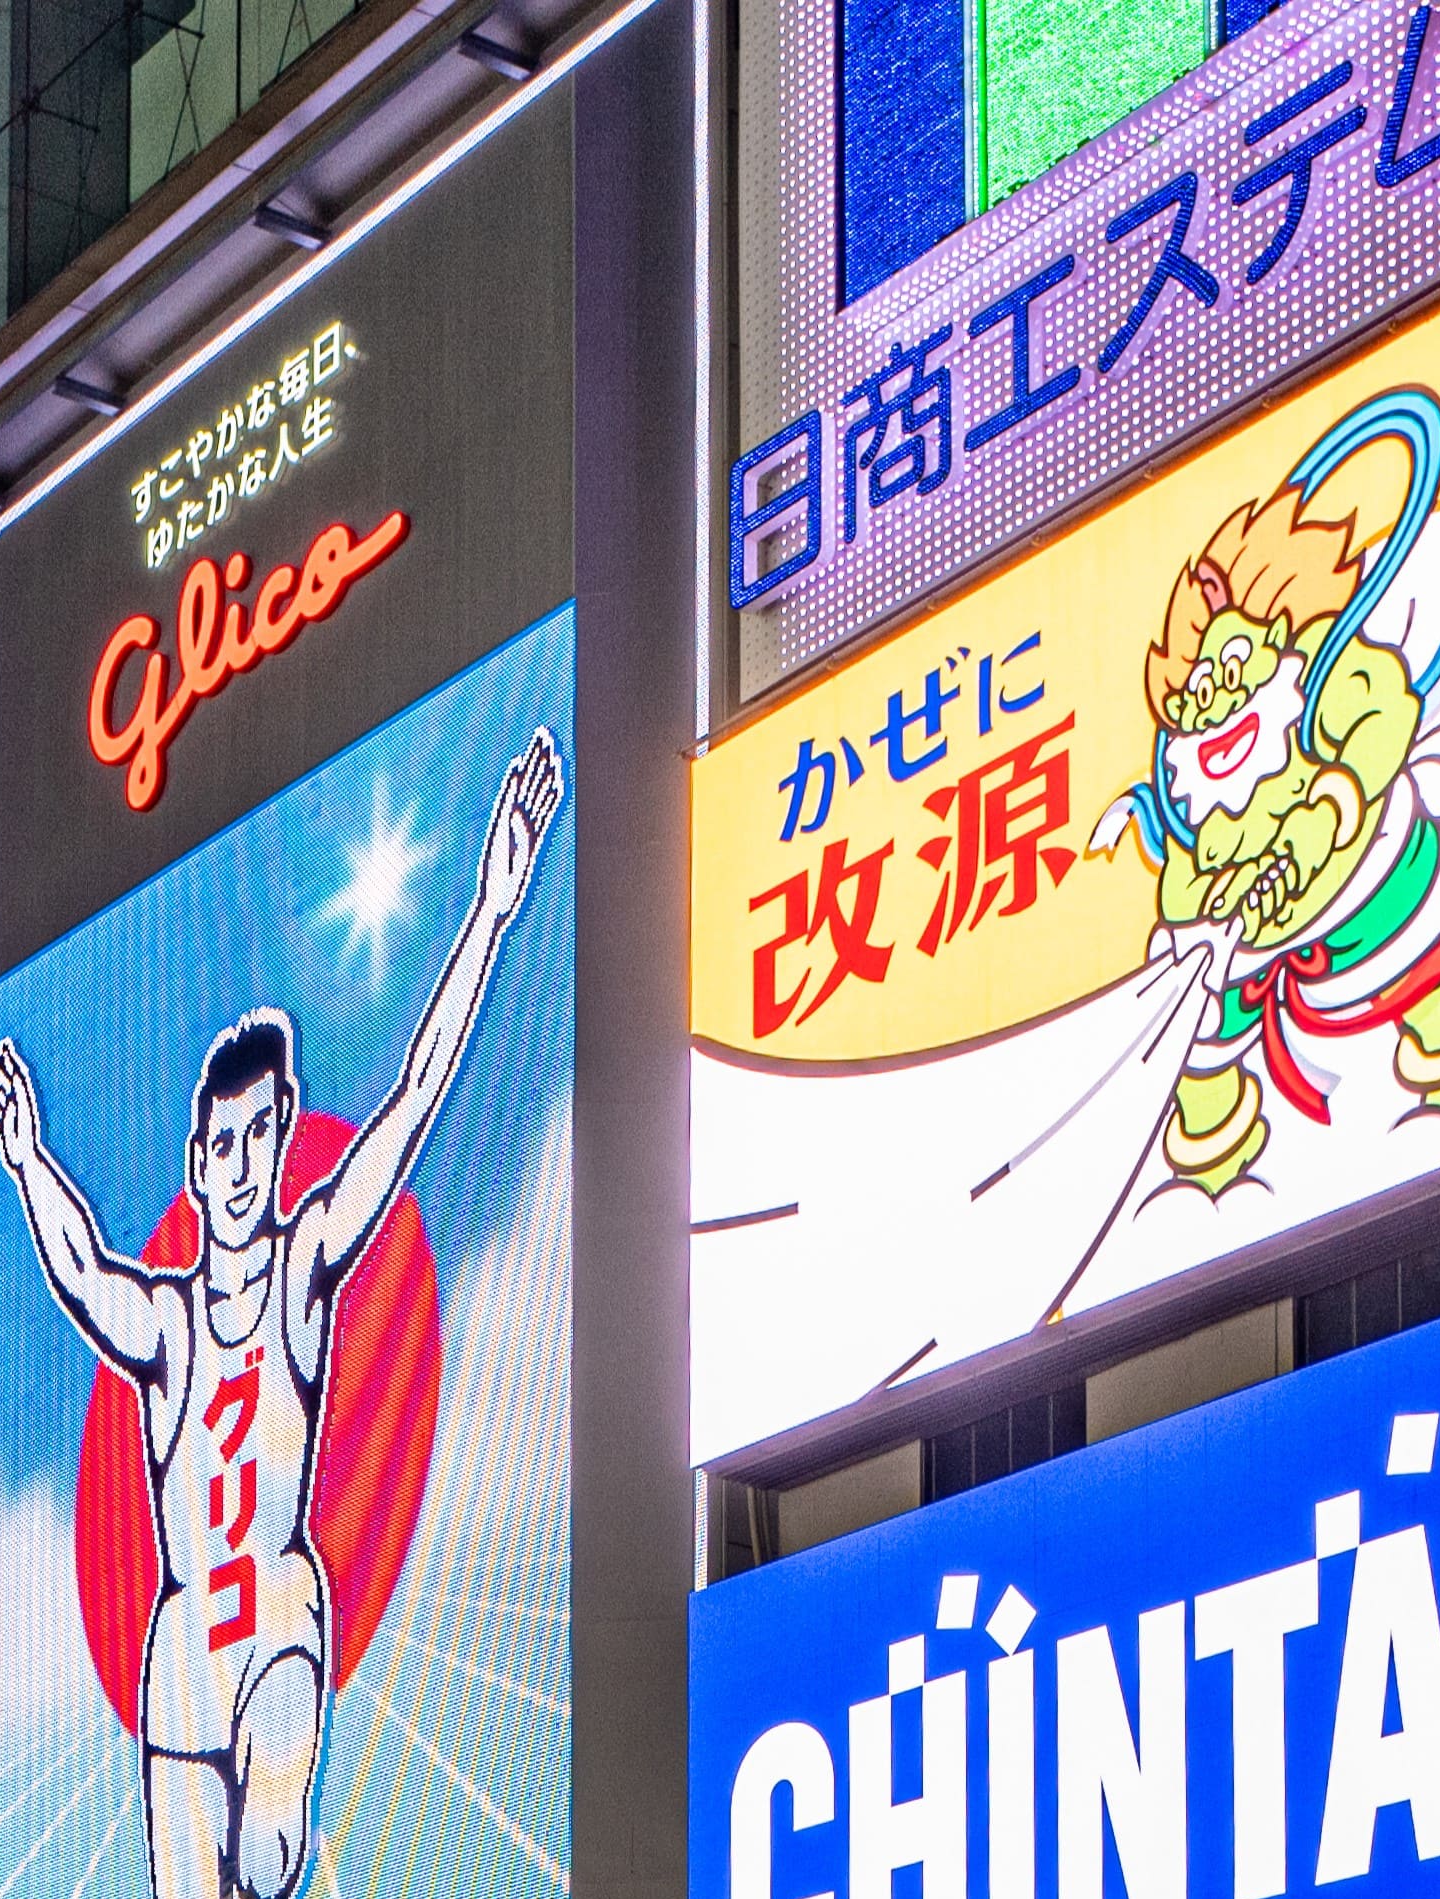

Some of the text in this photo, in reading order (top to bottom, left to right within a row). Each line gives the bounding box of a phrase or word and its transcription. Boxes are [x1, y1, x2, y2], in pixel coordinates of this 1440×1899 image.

[130, 320, 362, 523] すこやかな毎日、
[145, 396, 335, 569] ゆたかな人生
[87, 510, 411, 813] Glico
[777, 630, 1047, 845] かぜに
[747, 710, 1079, 1038] 改源
[203, 1346, 265, 1653] グリコ
